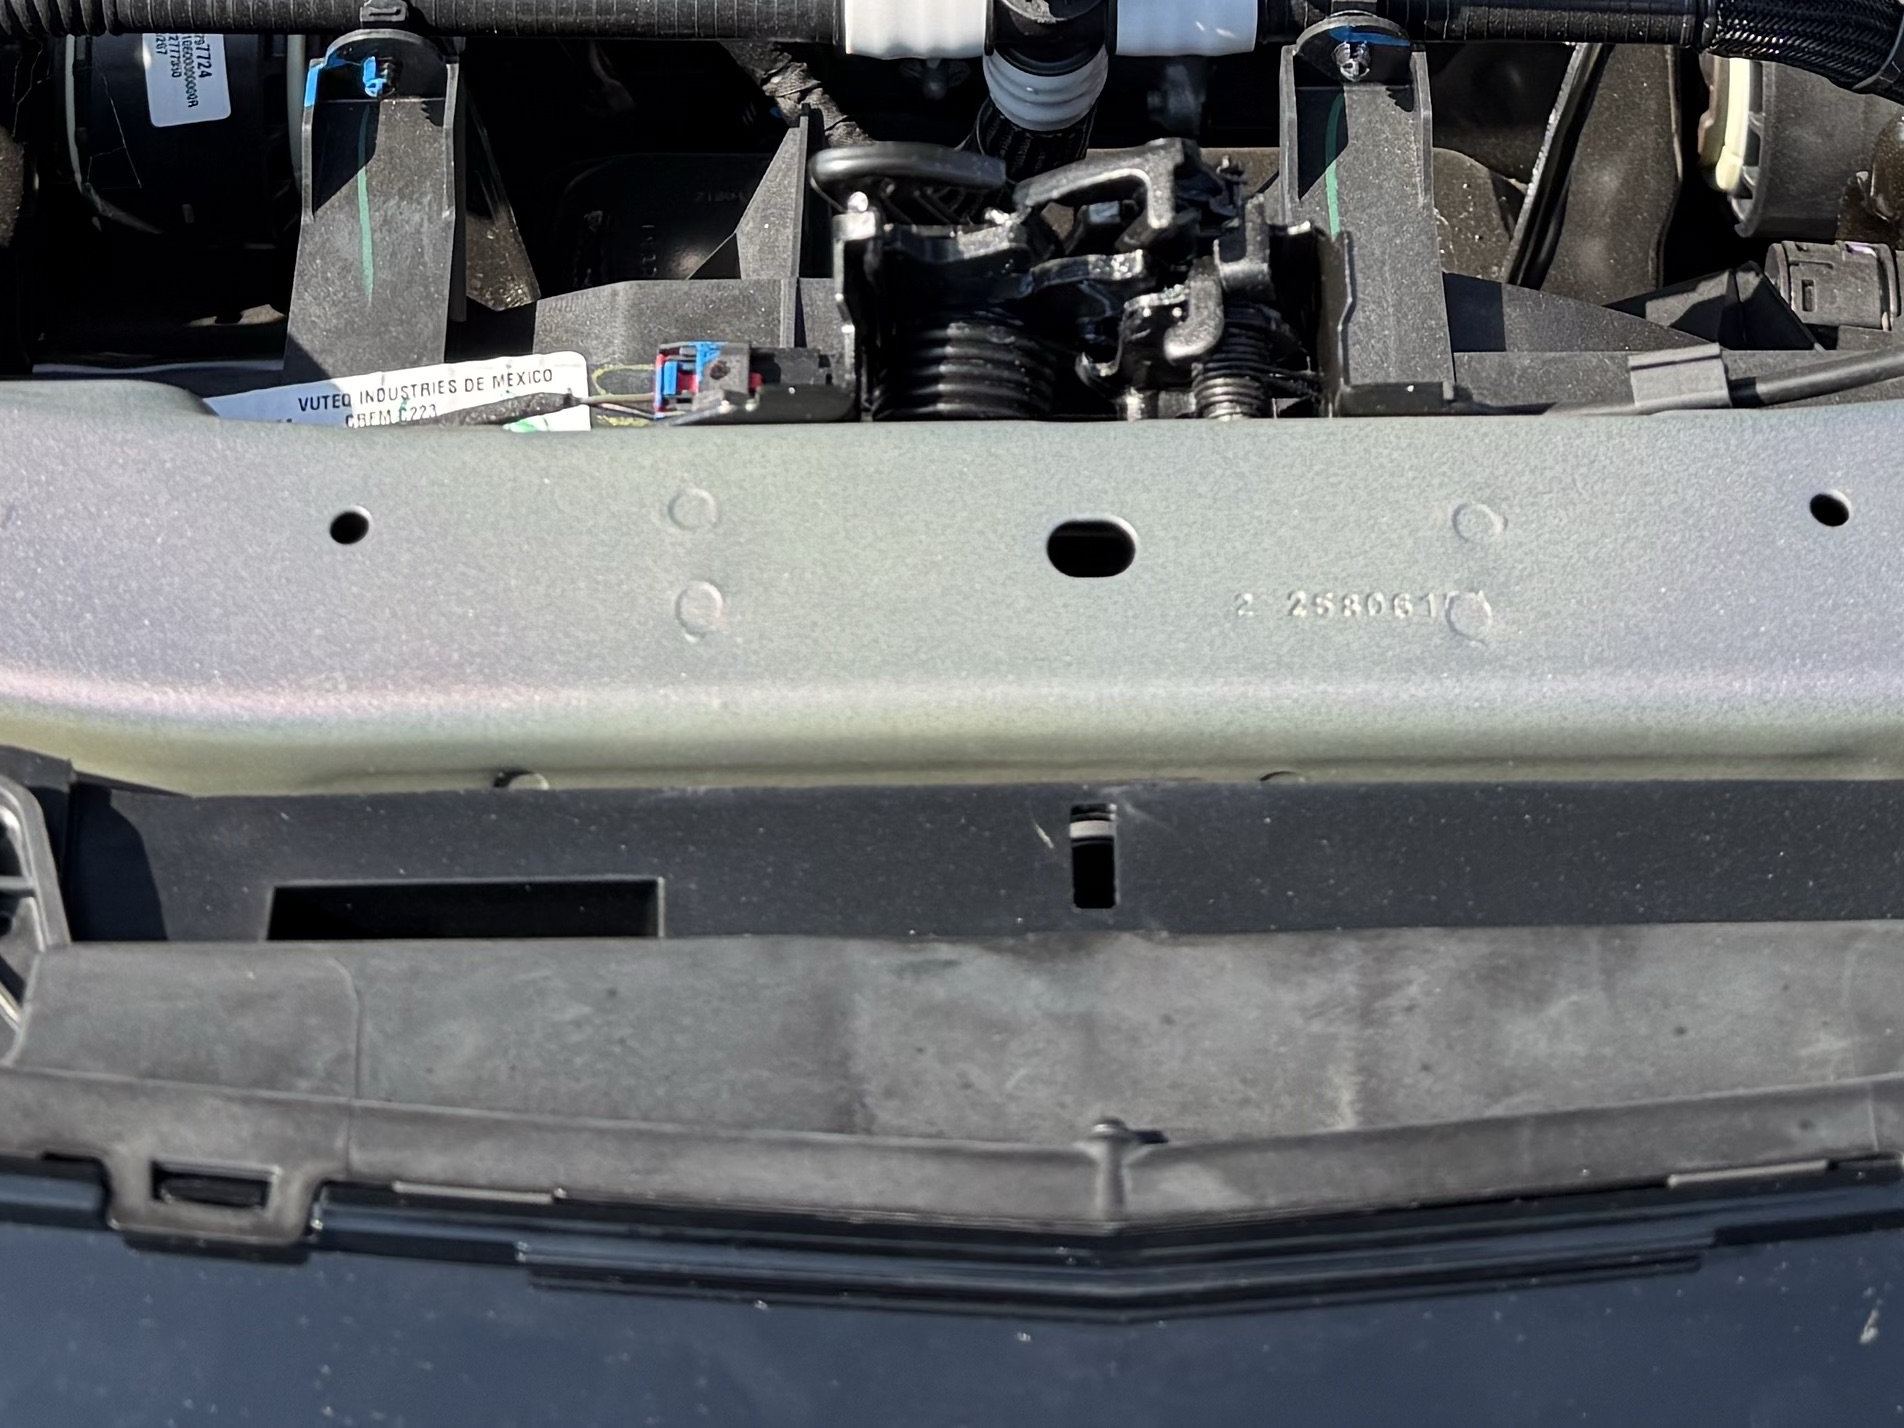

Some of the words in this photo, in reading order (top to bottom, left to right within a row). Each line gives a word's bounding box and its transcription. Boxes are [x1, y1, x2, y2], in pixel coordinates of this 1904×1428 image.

[297, 392, 353, 413] VUTEQ
[358, 378, 459, 406] INDUSTRIES
[464, 375, 486, 394] DE
[1287, 590, 1442, 619] 258061
